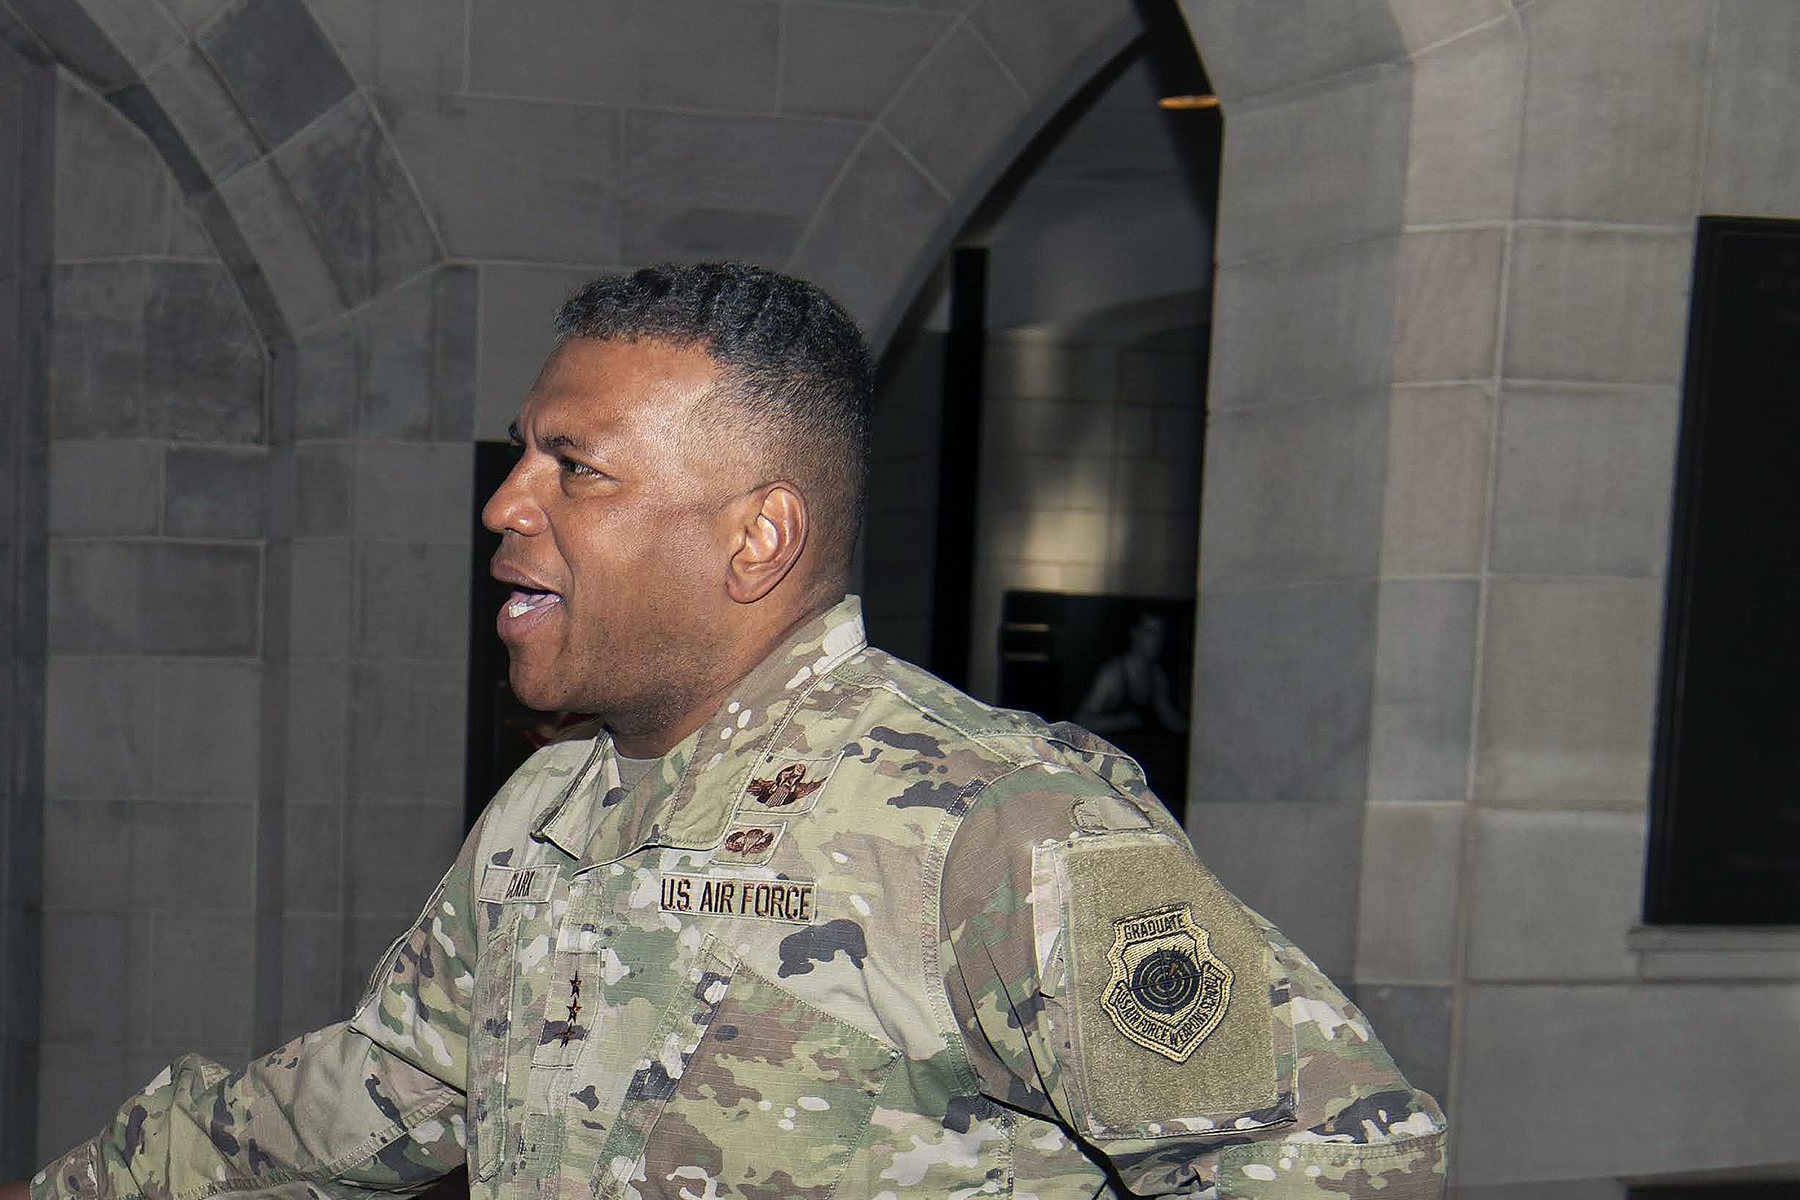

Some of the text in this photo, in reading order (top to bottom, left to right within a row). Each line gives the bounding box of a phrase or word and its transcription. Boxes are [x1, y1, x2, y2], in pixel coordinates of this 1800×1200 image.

[661, 878, 812, 920] U.S. AIR FORCE
[1123, 914, 1185, 940] GRADUATE
[1138, 1015, 1169, 1042] FORCE
[1170, 1008, 1210, 1047] WEAPONS
